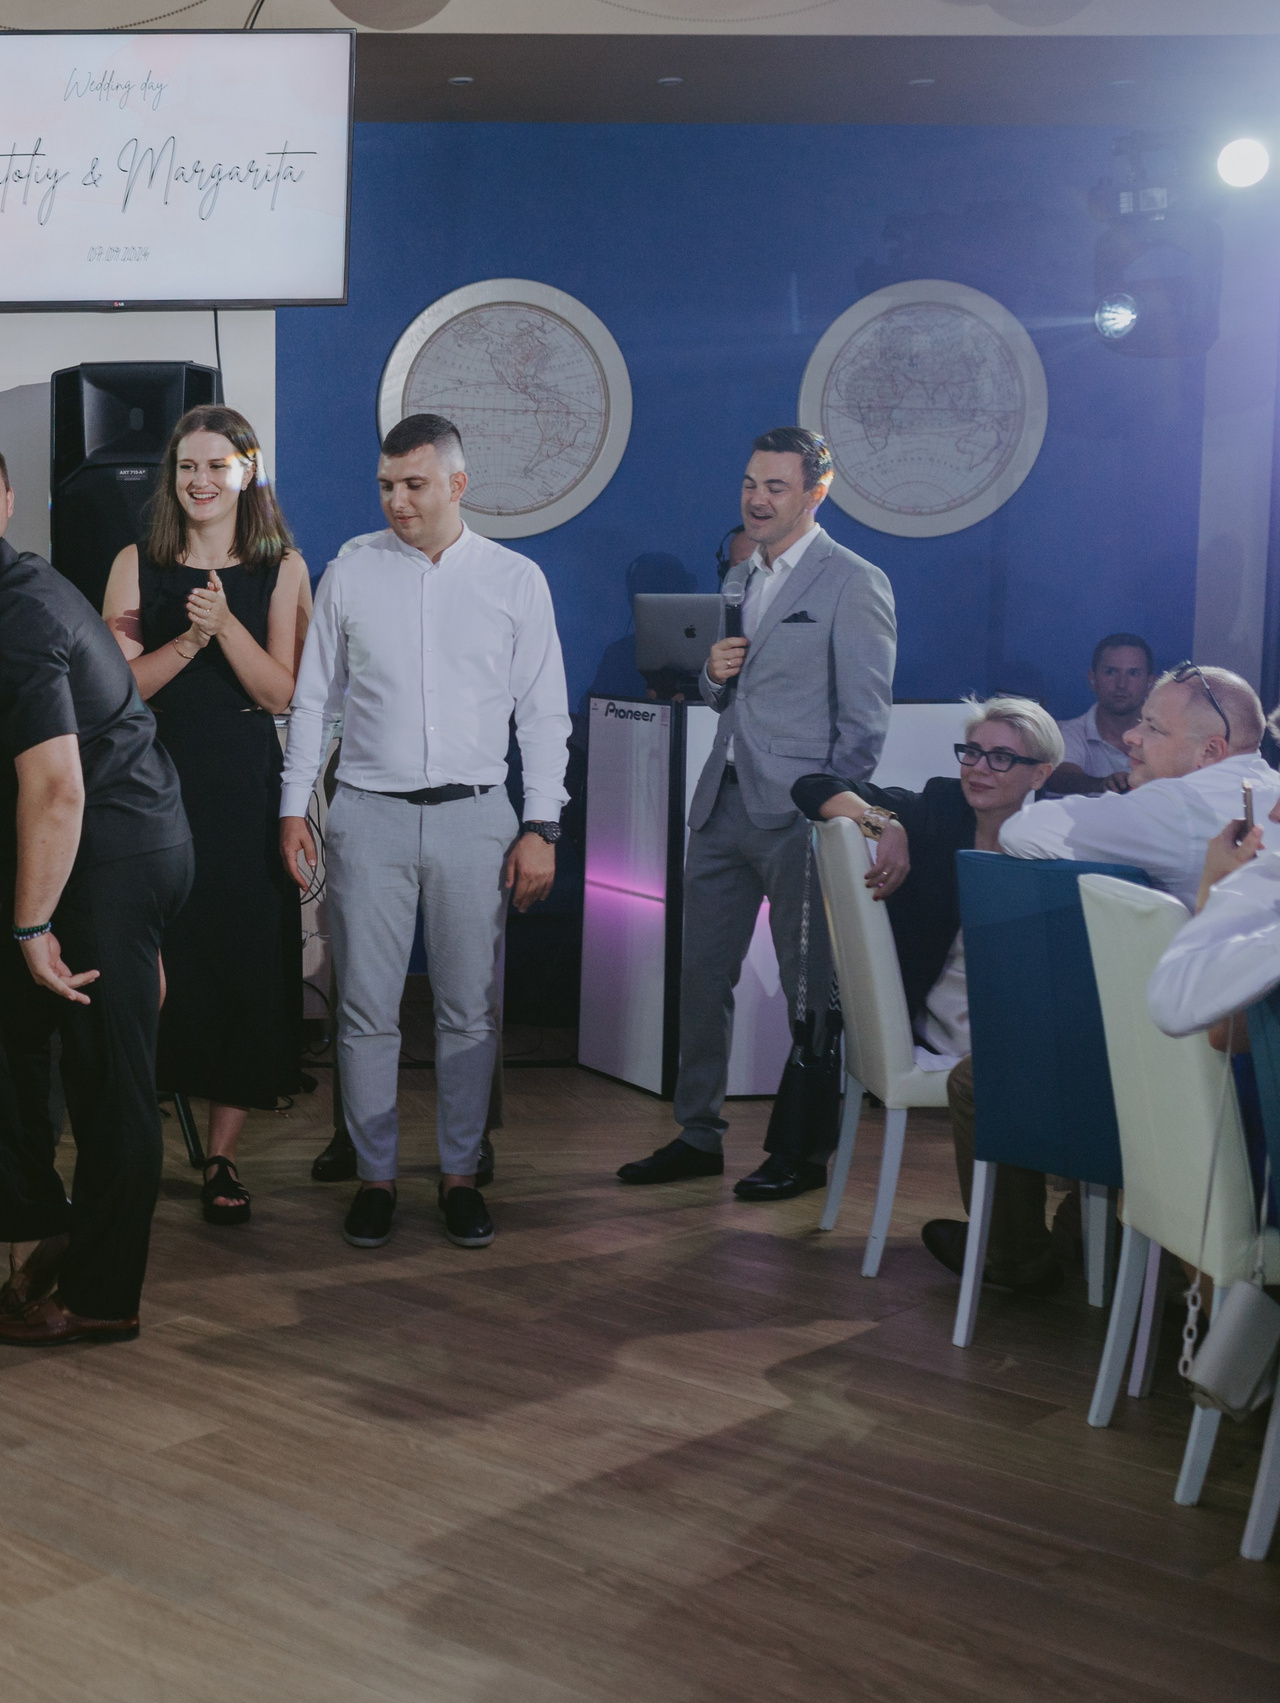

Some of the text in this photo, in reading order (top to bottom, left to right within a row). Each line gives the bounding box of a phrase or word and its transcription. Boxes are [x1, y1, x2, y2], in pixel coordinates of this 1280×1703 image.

[63, 67, 168, 111] Wedding day
[81, 157, 102, 188] &
[117, 135, 317, 221] Margarita
[604, 701, 656, 722] Pioneer
